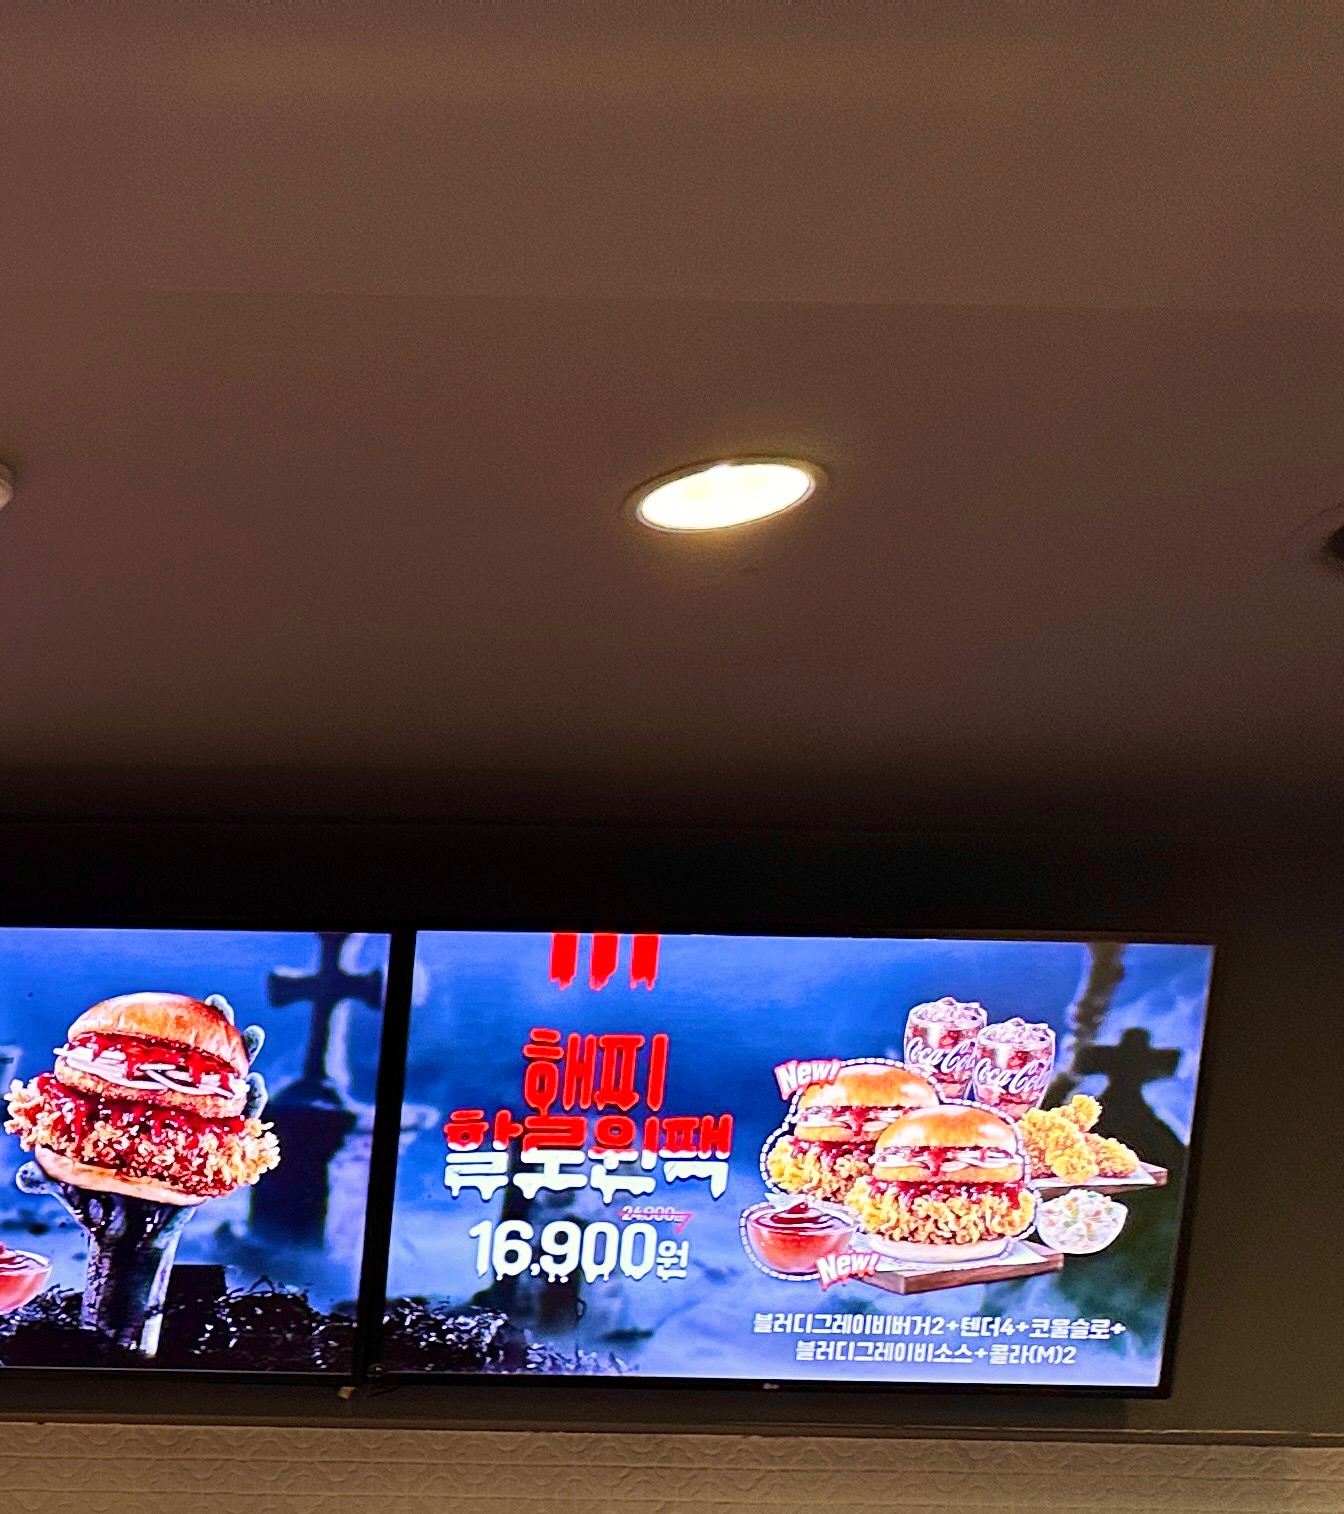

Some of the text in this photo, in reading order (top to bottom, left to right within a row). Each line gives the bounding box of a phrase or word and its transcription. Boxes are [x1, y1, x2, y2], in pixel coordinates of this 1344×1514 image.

[522, 1028, 670, 1112] 해피
[906, 1036, 976, 1074] Coca-Col
[443, 1110, 733, 1204] 할로윈팩
[468, 1220, 690, 1284] 16,900원
